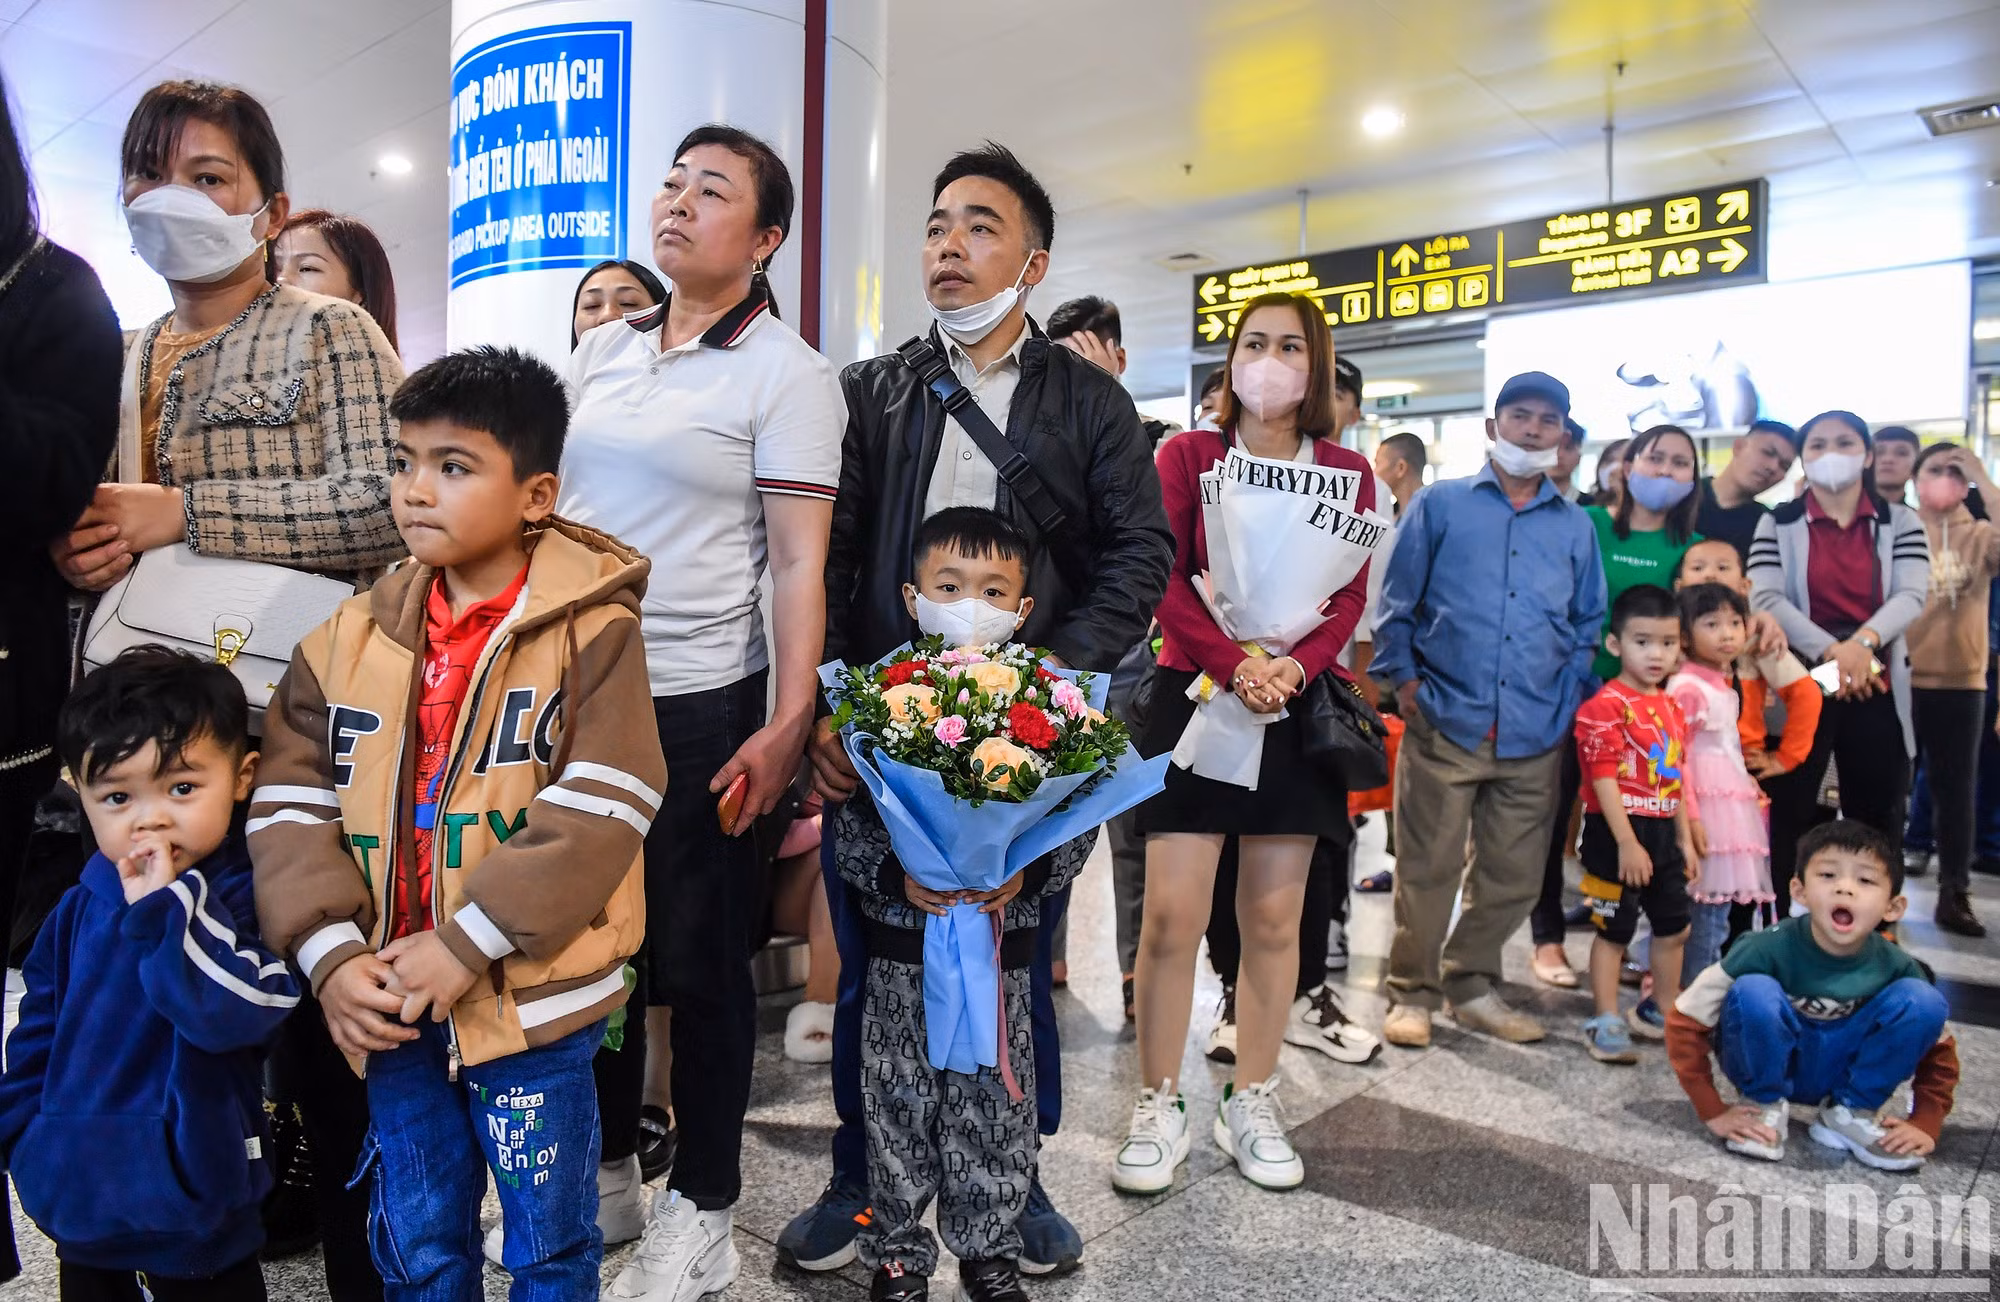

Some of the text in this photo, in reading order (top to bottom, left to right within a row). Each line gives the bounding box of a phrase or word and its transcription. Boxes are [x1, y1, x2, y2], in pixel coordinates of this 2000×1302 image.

[483, 63, 519, 117] ĐÓN
[524, 52, 604, 106] KHÁCH
[525, 130, 558, 187] PHÍA
[561, 126, 609, 184] NGOÀI
[511, 214, 545, 243] AREA
[548, 211, 610, 239] OUTSIDE
[1615, 208, 1652, 238] 3F
[1658, 247, 1700, 277] A2
[1228, 454, 1356, 501] EVERYDAY
[512, 1096, 542, 1108] LEXA
